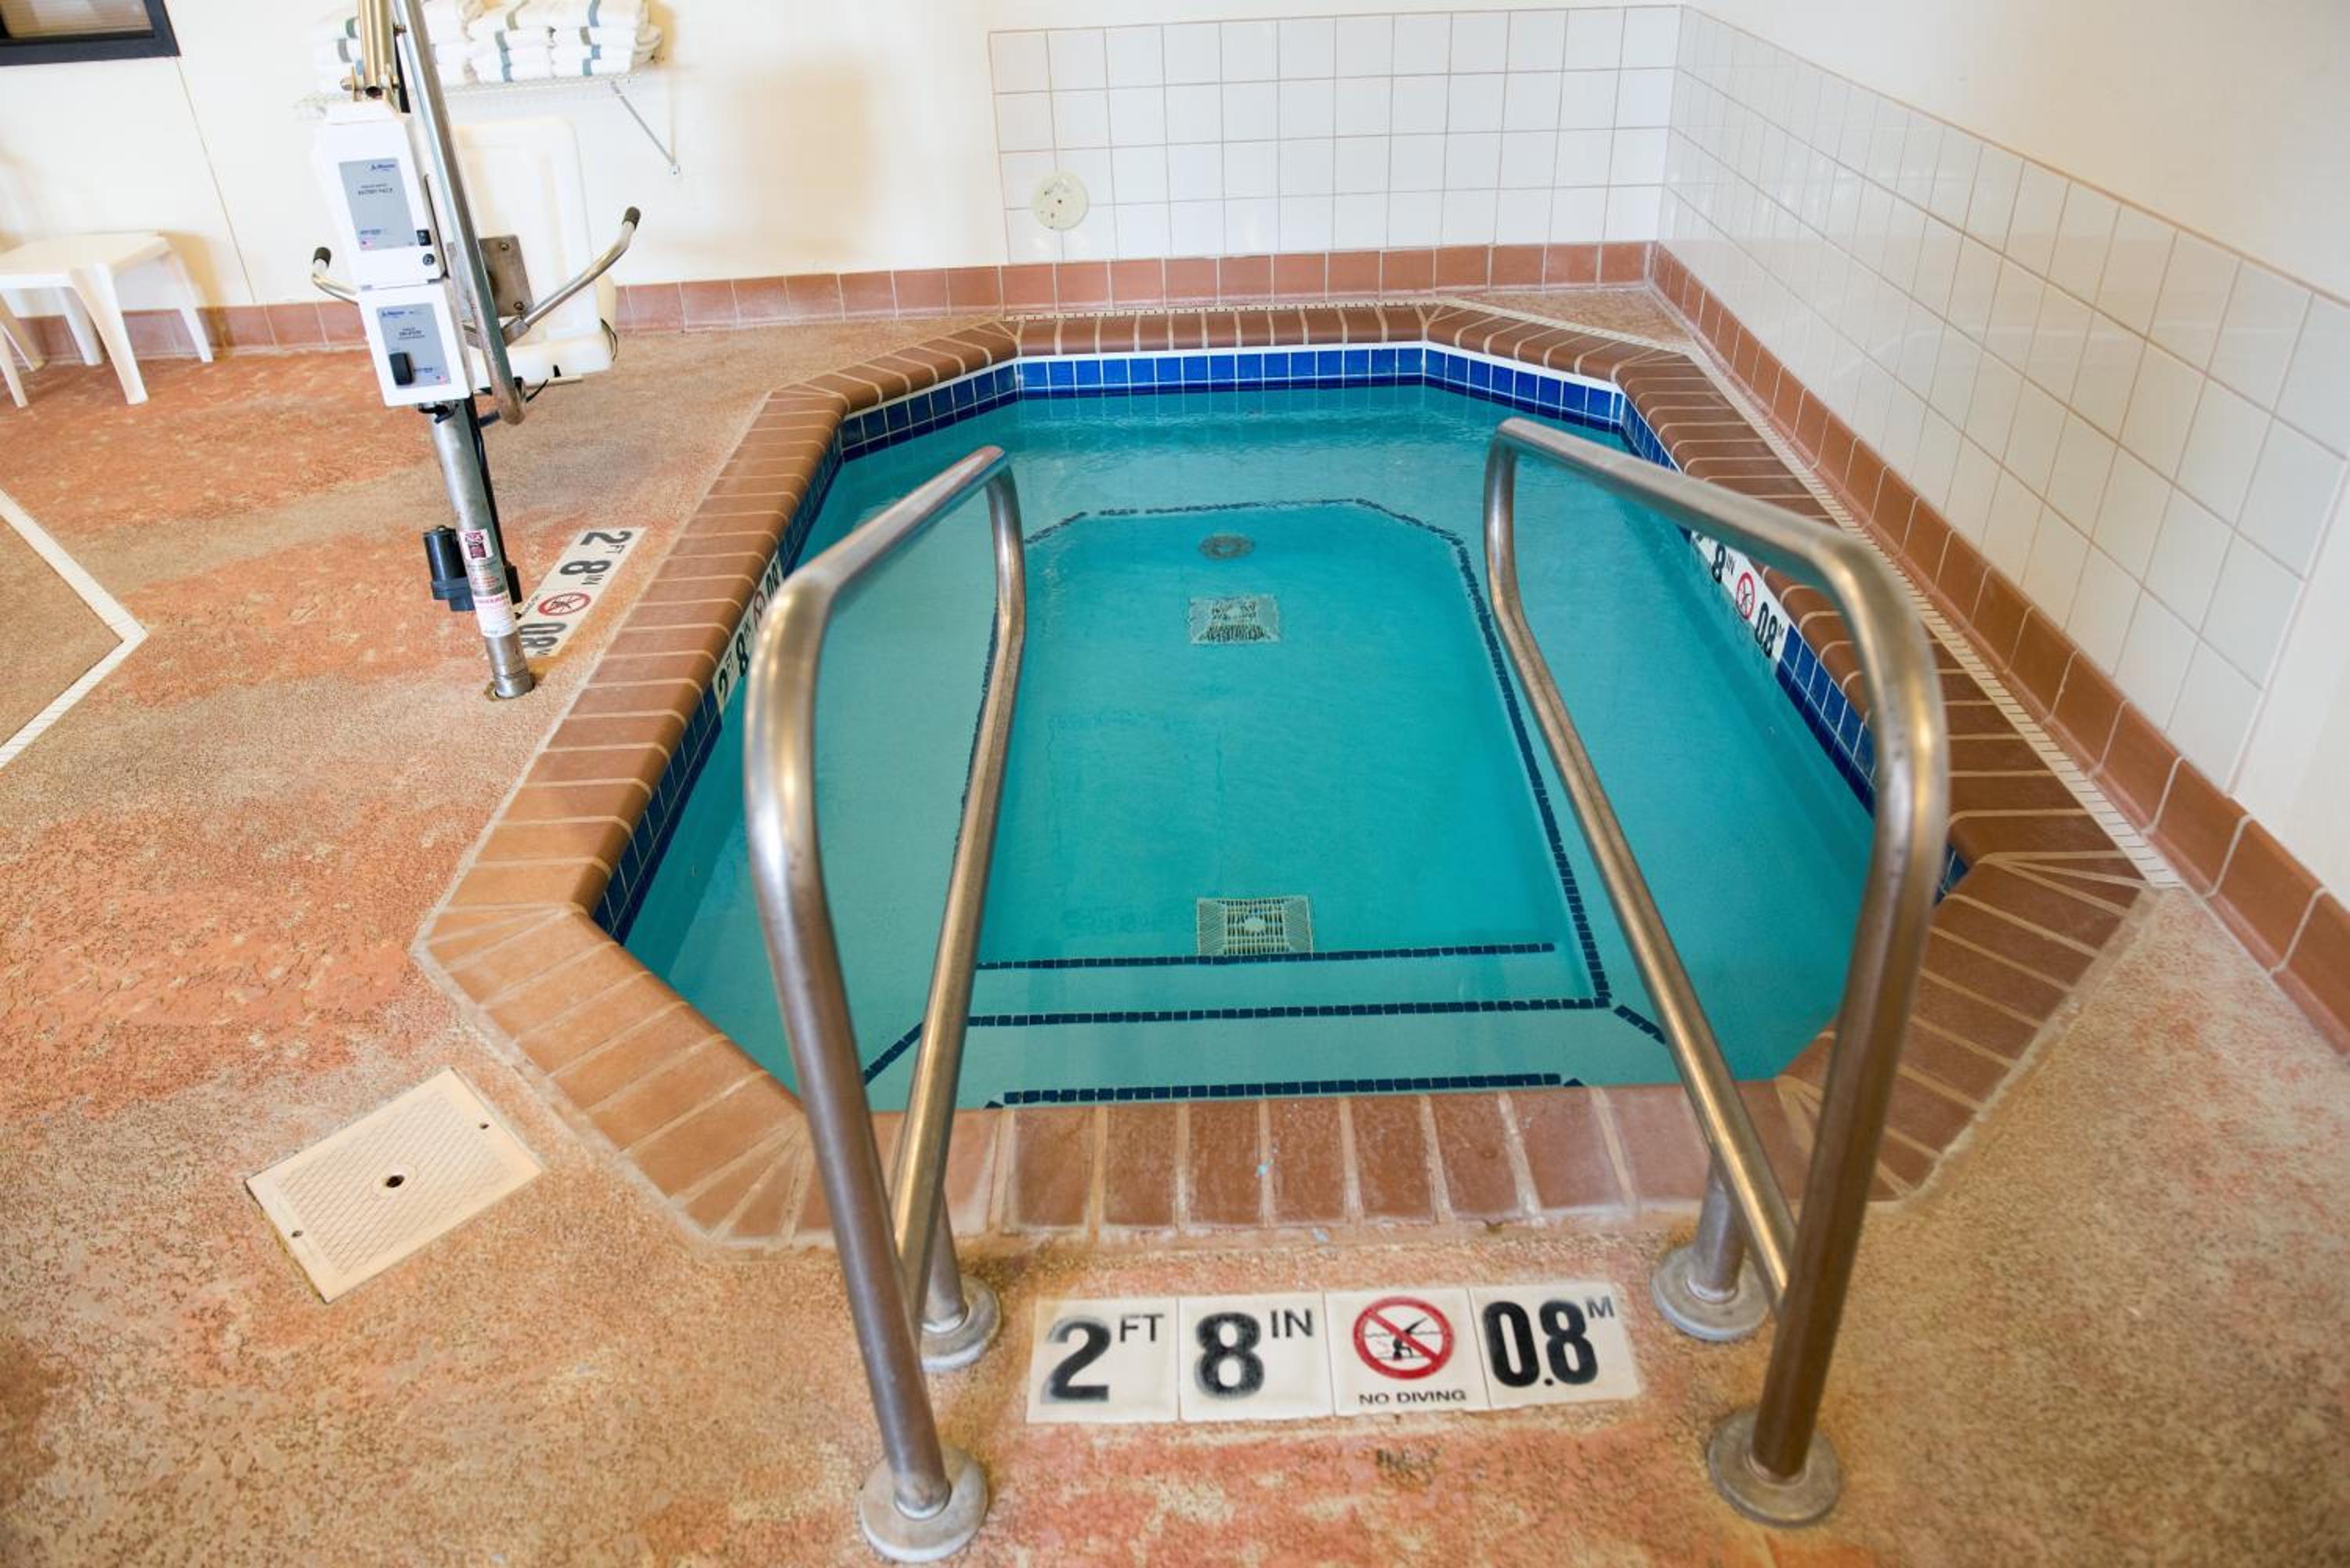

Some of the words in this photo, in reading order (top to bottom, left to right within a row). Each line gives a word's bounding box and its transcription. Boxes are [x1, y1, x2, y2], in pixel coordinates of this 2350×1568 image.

[580, 531, 633, 546] 2
[559, 560, 613, 576] 8
[519, 623, 567, 649] 08
[1041, 1316, 1111, 1403] 2
[1119, 1313, 1164, 1342] FT
[1195, 1312, 1265, 1399] 8
[1271, 1309, 1314, 1338] IN
[1483, 1300, 1599, 1388] 0.8
[1587, 1295, 1615, 1319] M
[1359, 1393, 1390, 1404] NO
[1397, 1389, 1467, 1404] DIVING
